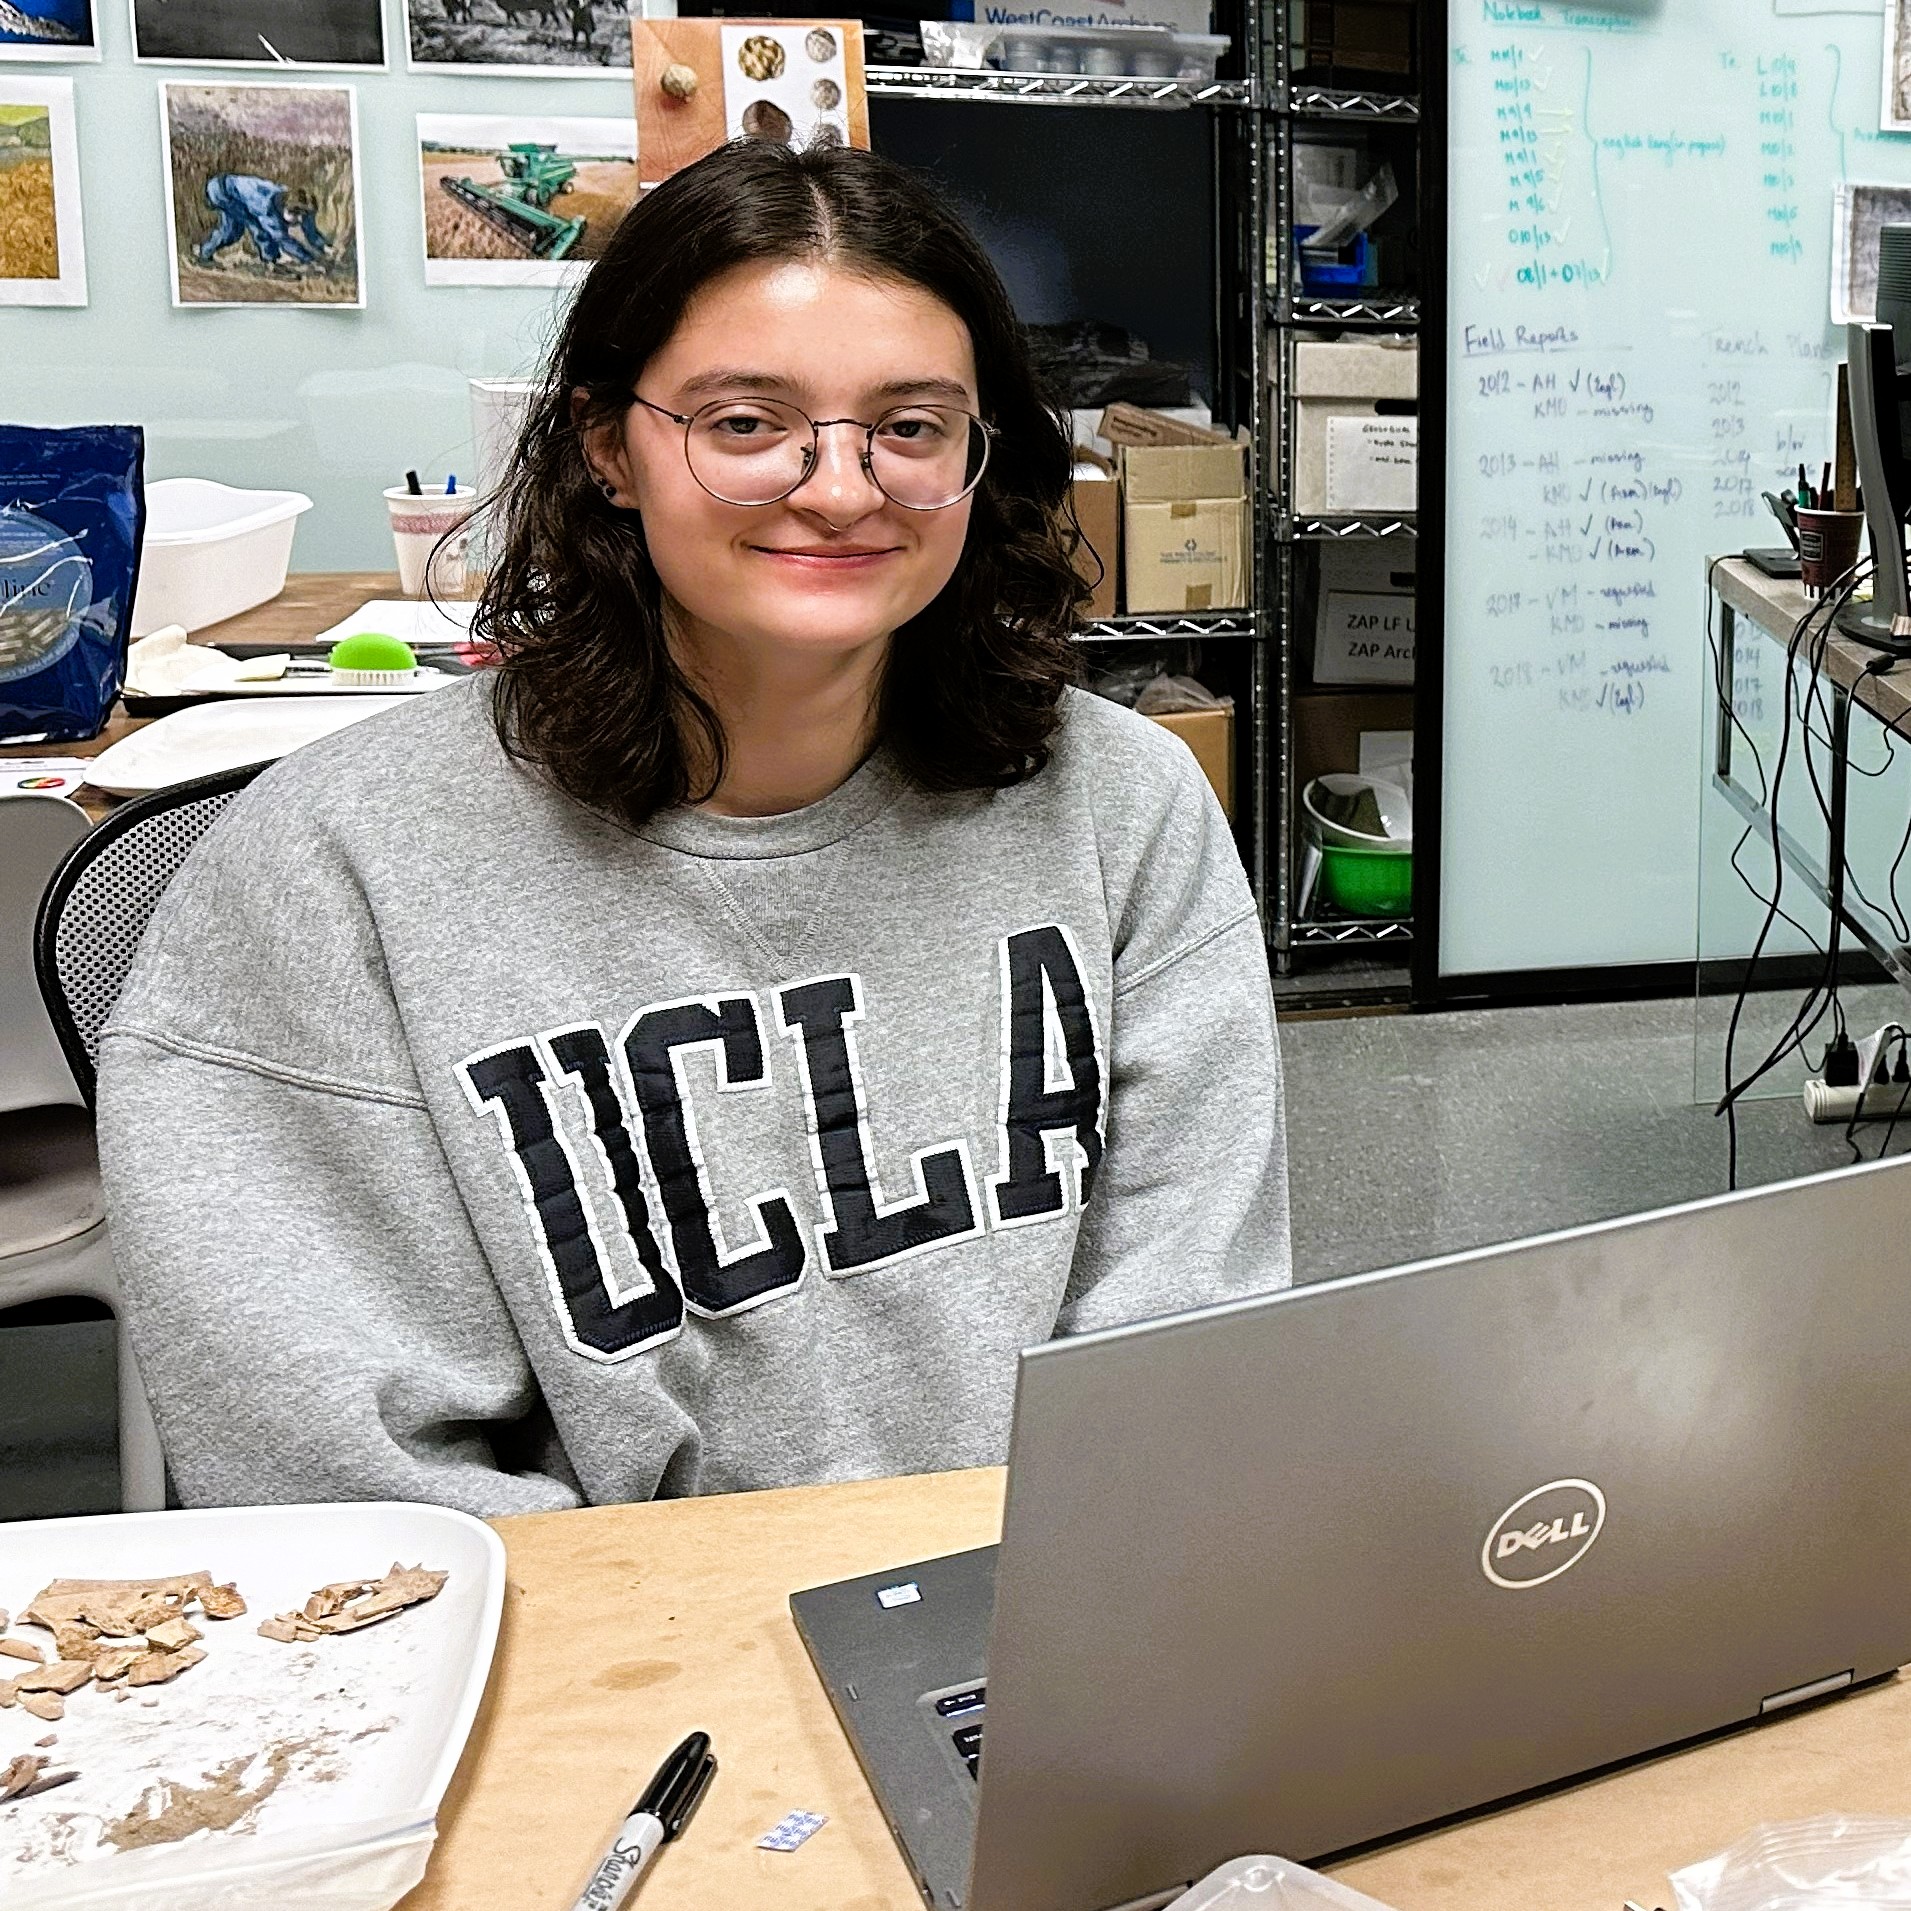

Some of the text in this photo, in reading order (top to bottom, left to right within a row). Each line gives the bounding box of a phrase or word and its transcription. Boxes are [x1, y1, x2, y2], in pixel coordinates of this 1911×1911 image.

[1464, 324, 1579, 353] Field Reports
[1479, 369, 1511, 397] 2012
[1532, 373, 1556, 393] AH
[1593, 403, 1654, 423] missing
[1479, 452, 1517, 478] 2013
[1591, 451, 1644, 473] missing
[1713, 476, 1754, 497] 2017
[1347, 613, 1379, 630] ZAP
[1383, 616, 1402, 631] LF
[1348, 641, 1380, 657] ZAP
[1735, 677, 1763, 695] 017
[453, 923, 1106, 1365] UCLA
[1497, 1512, 1591, 1558] DELL
